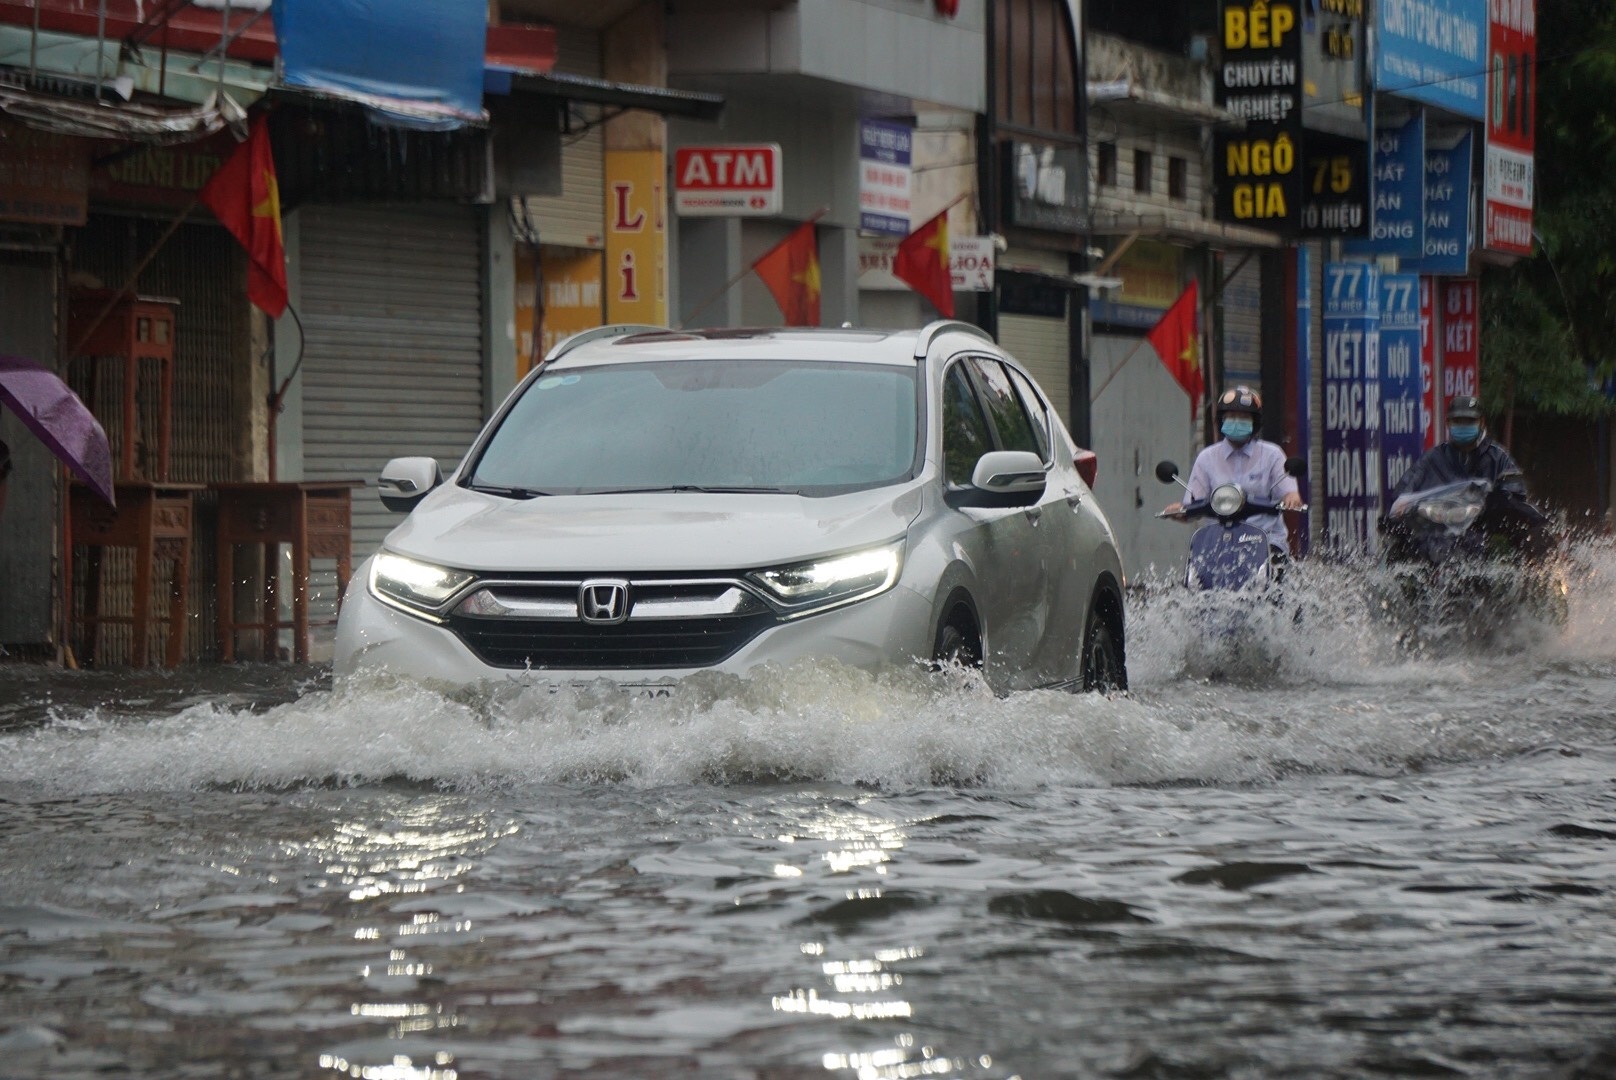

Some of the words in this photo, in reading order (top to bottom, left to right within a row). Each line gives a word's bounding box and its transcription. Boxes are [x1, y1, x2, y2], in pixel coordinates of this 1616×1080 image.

[1225, 0, 1294, 49] BẾP
[1224, 57, 1295, 87] CHUYÊN
[1226, 91, 1293, 124] NGHIỆP
[683, 152, 768, 186] ATM
[1227, 132, 1294, 176] NGÔ
[1311, 155, 1351, 194] 75
[1233, 183, 1286, 219] GIA
[1322, 202, 1362, 233] HIỆU
[1329, 266, 1362, 300] 77
[1383, 281, 1412, 313] 77
[1446, 286, 1473, 315] 81
[1327, 320, 1362, 379] KÉT
[1446, 319, 1473, 353] KÉT
[1387, 338, 1411, 386] NỘI
[1326, 381, 1363, 439] BẠC
[1384, 388, 1415, 435] THẤT
